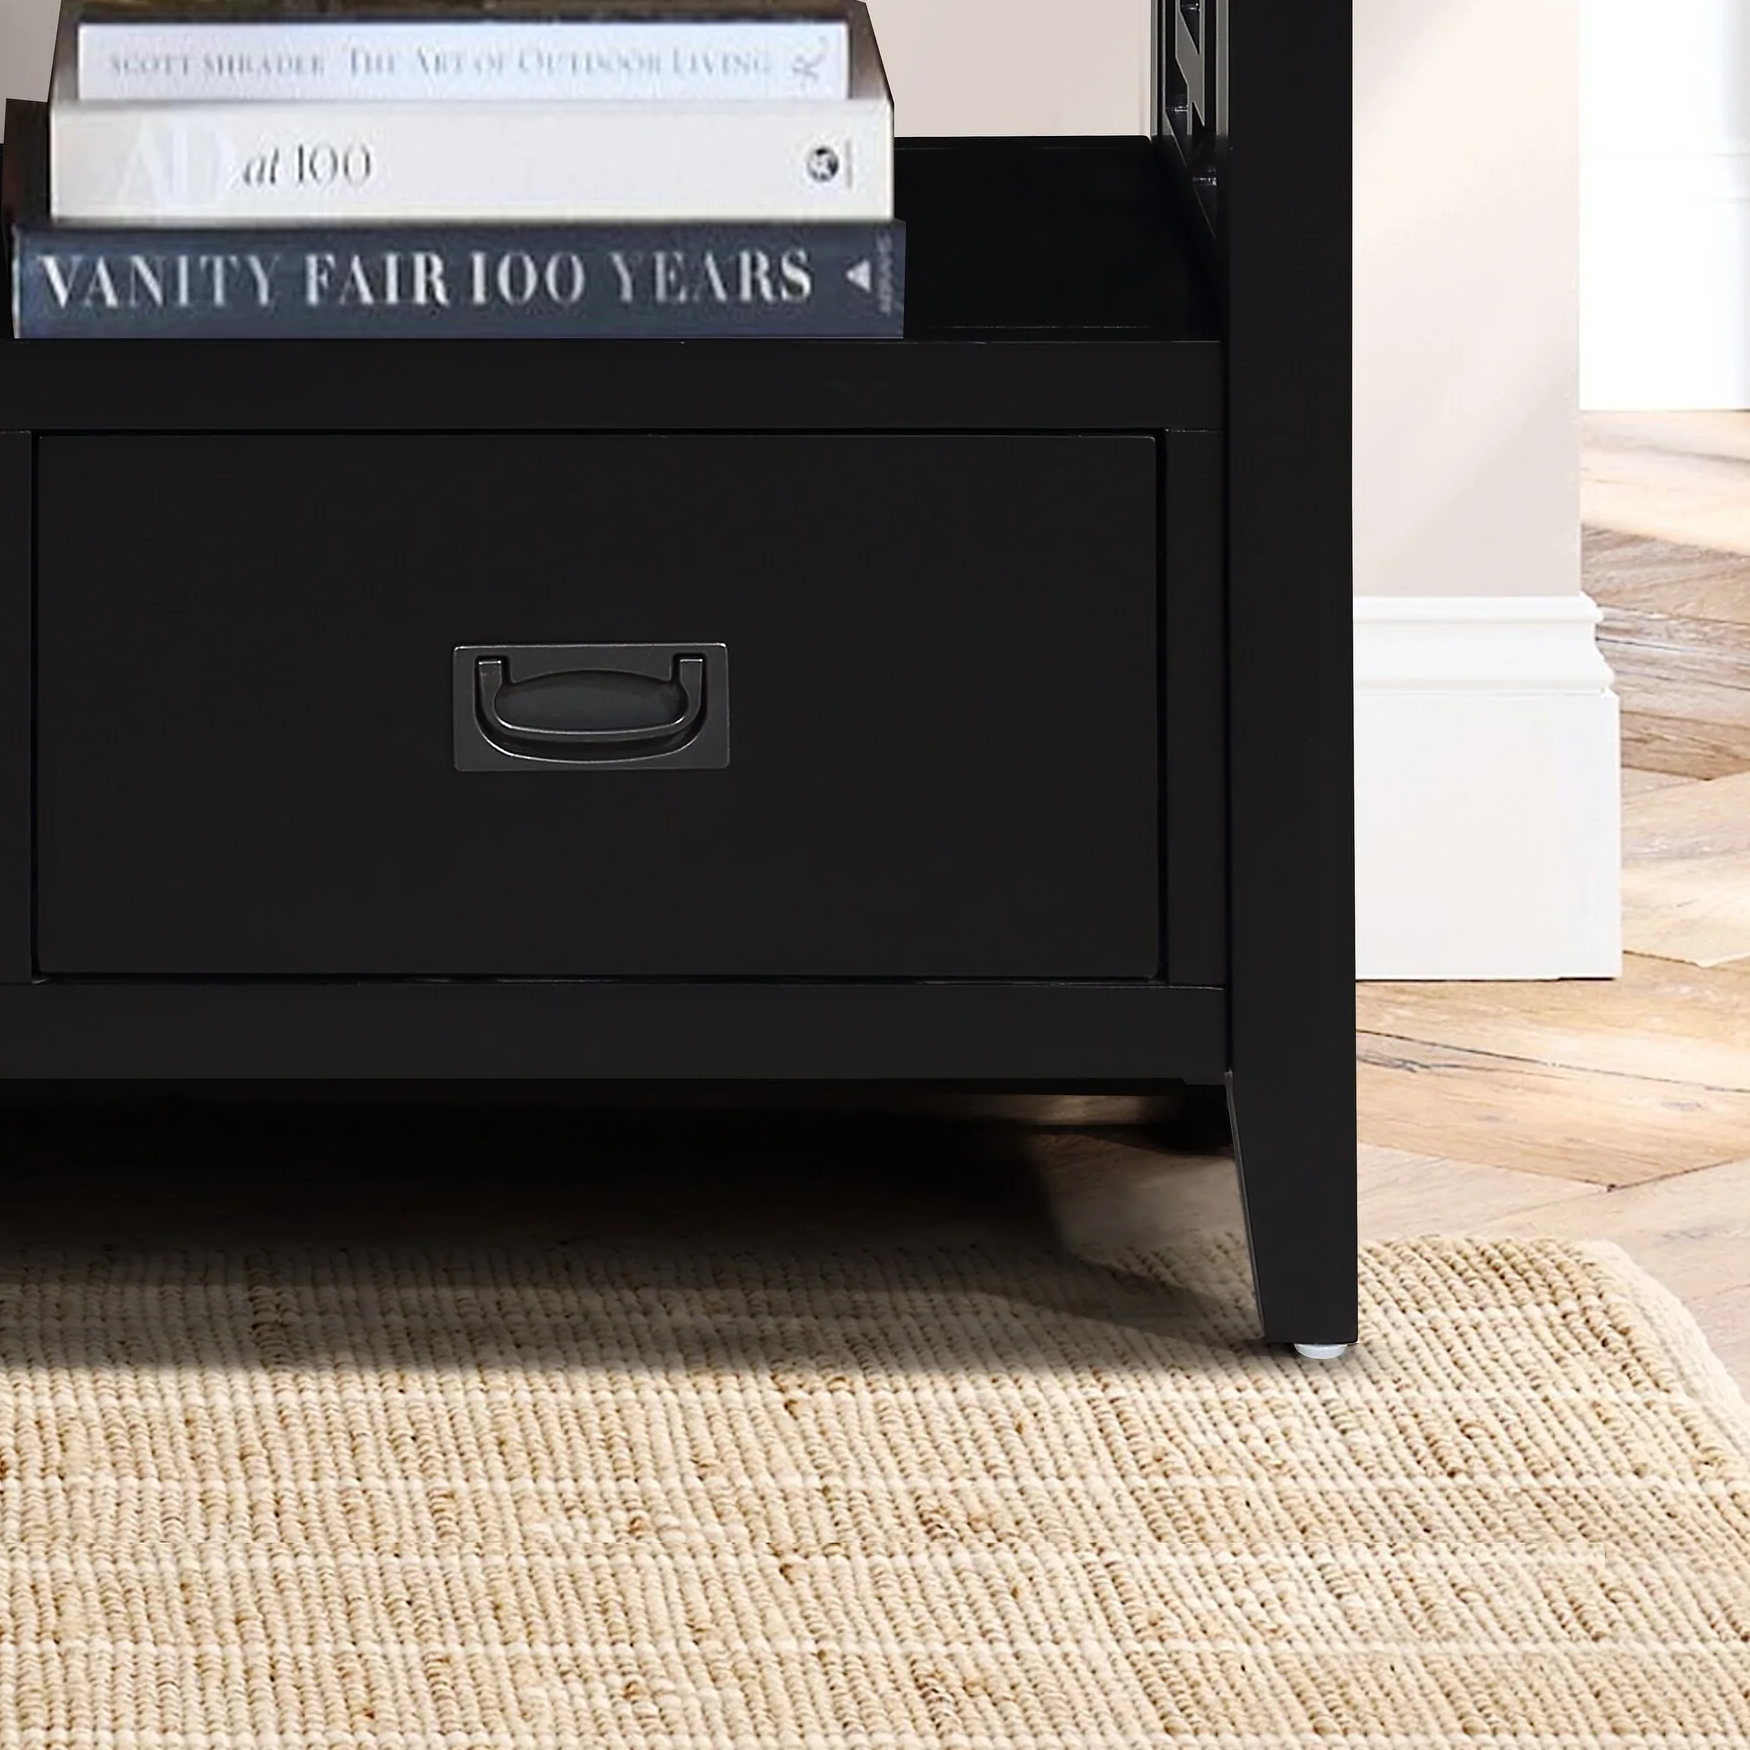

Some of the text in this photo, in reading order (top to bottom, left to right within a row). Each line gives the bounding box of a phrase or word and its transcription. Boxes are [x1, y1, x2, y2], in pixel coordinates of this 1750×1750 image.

[242, 147, 279, 186] at
[296, 142, 371, 186] 100
[40, 254, 279, 307] VANITY
[304, 252, 450, 306] FAIR
[471, 251, 585, 305] 100
[611, 249, 813, 304] YEARS
